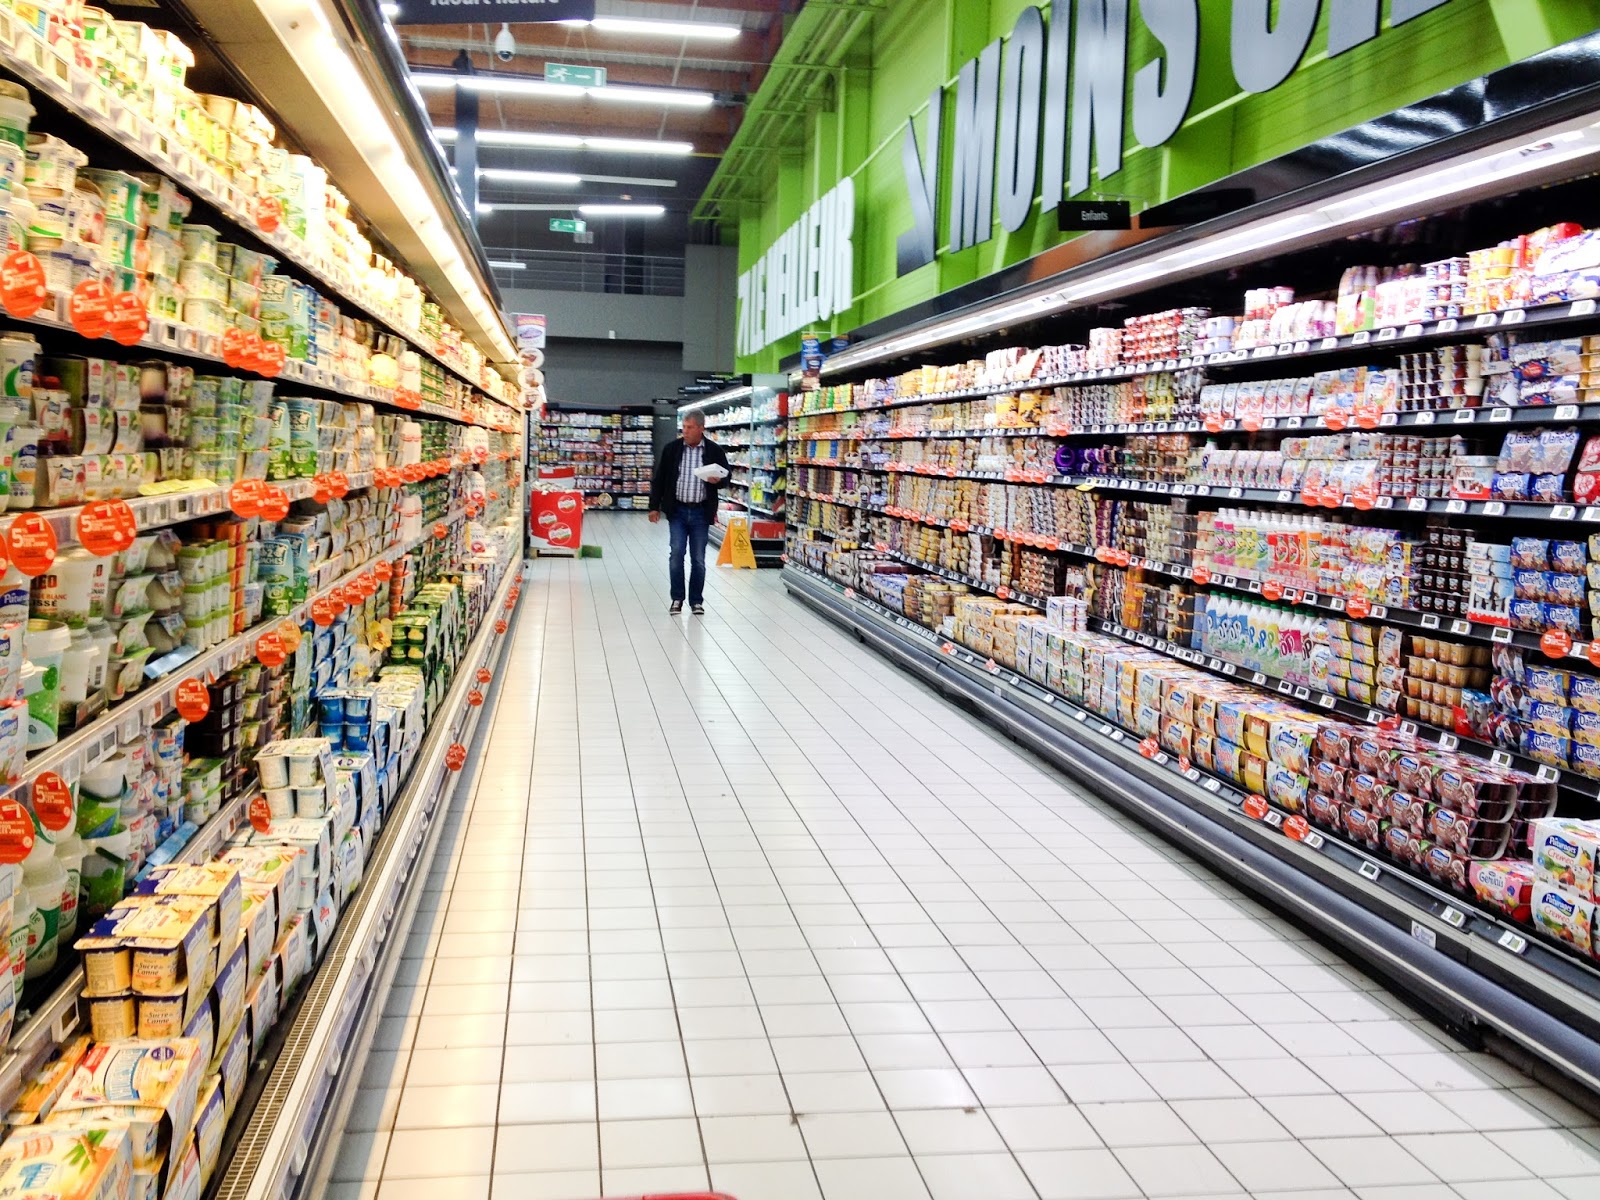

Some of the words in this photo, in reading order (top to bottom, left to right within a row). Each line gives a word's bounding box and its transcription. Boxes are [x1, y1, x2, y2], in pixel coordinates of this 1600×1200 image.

[1081, 210, 1109, 221] Enfants
[1533, 673, 1557, 688] Danette
[1537, 705, 1563, 719] Danette
[1535, 736, 1560, 751] Danette
[1479, 871, 1504, 888] Gervais
